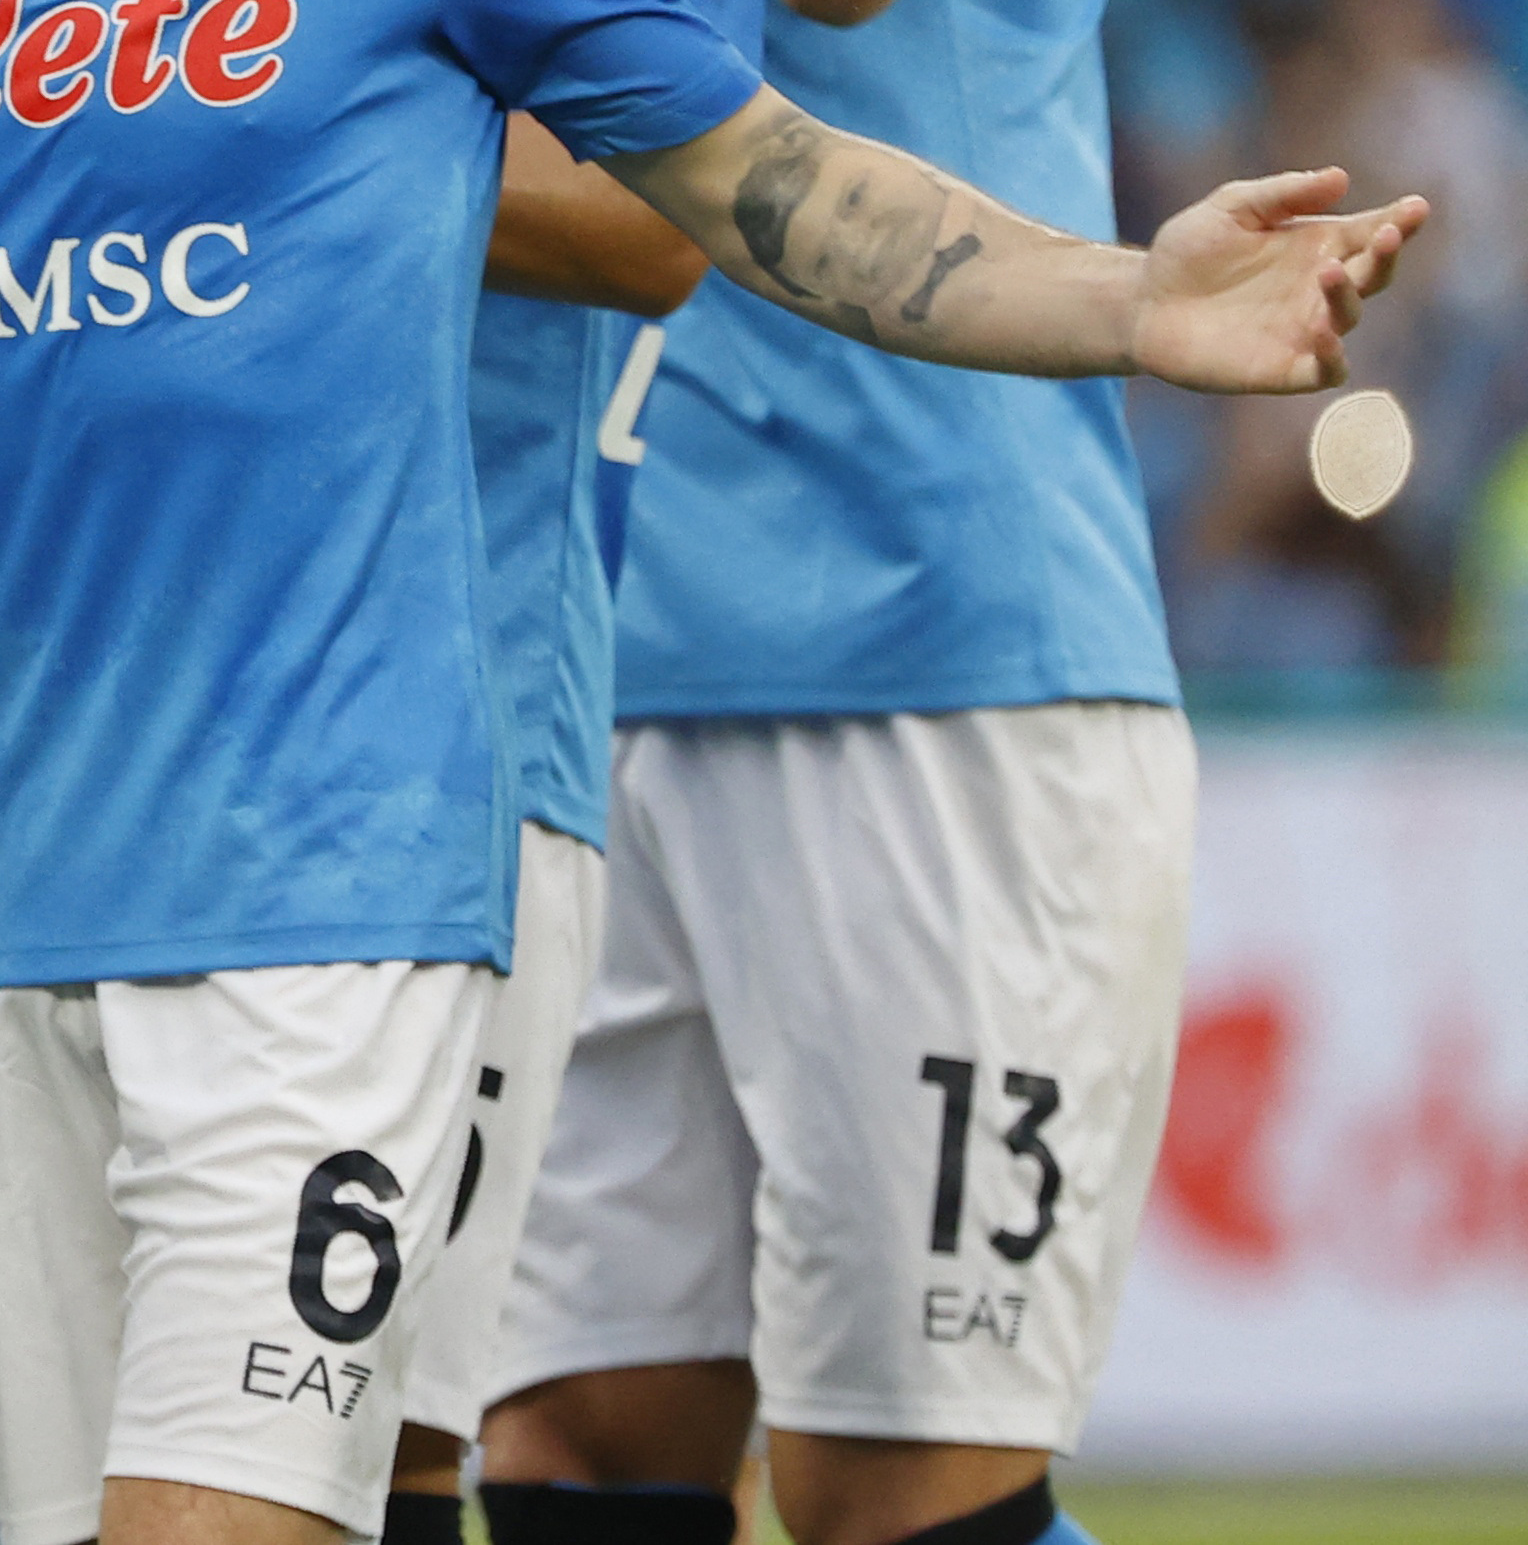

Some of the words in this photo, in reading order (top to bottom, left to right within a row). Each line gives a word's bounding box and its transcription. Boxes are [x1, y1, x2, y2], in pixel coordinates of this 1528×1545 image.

[288, 1148, 405, 1345] 6
[921, 1055, 1061, 1262] 13
[242, 1341, 373, 1421] EA7
